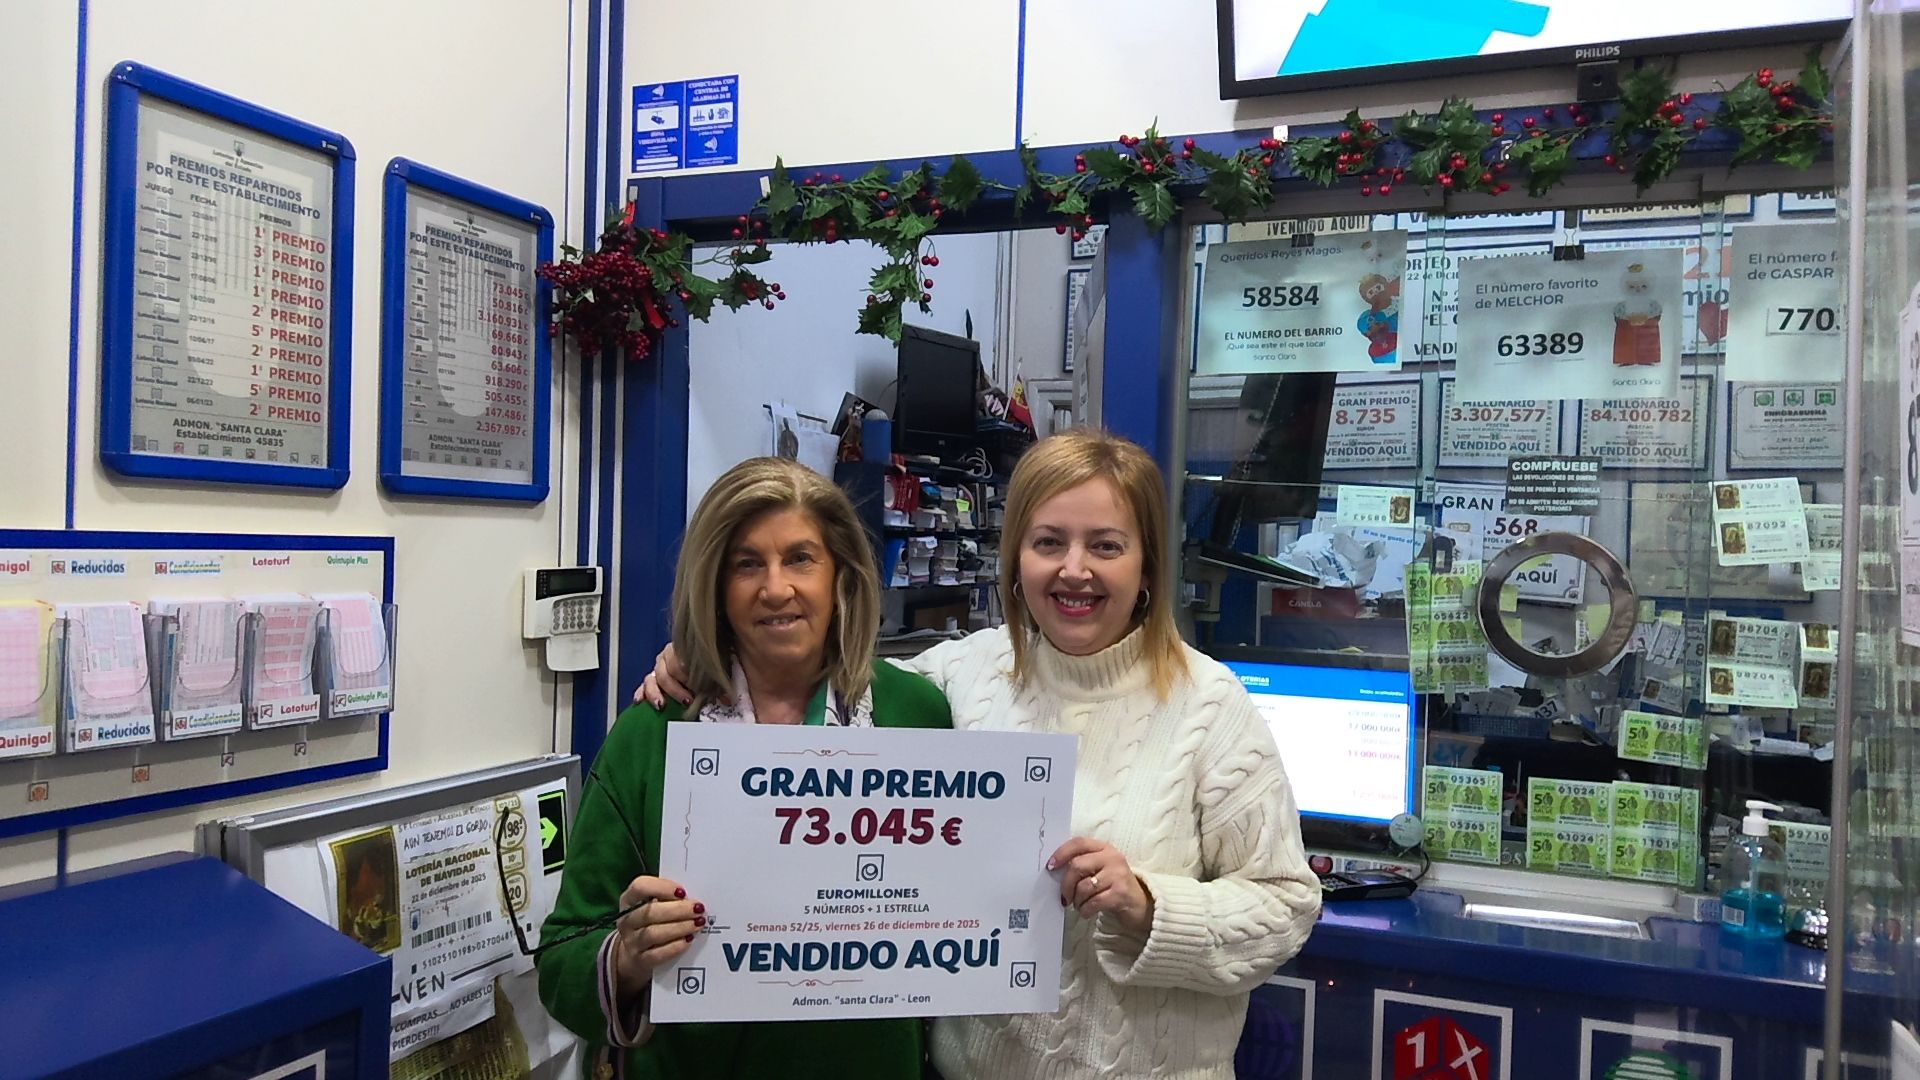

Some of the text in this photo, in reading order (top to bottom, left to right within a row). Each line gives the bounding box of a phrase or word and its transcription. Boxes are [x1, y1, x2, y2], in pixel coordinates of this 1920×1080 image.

[1576, 46, 1621, 59] PHILIPS
[170, 154, 226, 180] PREMIOS
[230, 174, 302, 202] REPARTIDOS
[145, 182, 174, 195] JUEGO
[146, 162, 174, 179] POR
[177, 170, 209, 188] ESTE
[213, 180, 321, 220] ESTABLECIMIENTO
[272, 230, 325, 254] PREMIO
[425, 225, 463, 243] PREMIOS
[464, 237, 513, 259] REPARTIDOS
[410, 232, 526, 272] POR ESTE ESTABLECIMIENTO
[1220, 249, 1303, 263] Queridos Reyes
[1749, 252, 1826, 264] El número
[272, 250, 325, 273] PREMIO
[272, 270, 324, 292] PREMIO
[1747, 268, 1834, 280] de GASPAR
[493, 282, 524, 299] 73.045
[1476, 278, 1598, 295] El número favorito
[271, 289, 324, 310] PREMIO
[1242, 285, 1320, 308] 58584
[1475, 294, 1564, 310] de MELCHOR
[492, 298, 524, 314] 50.816
[271, 308, 324, 330] PREMIO
[478, 310, 522, 330] 3.160.931
[1778, 307, 1841, 331] 770
[270, 328, 323, 348] PREMIO
[492, 329, 523, 345] 69.668
[1224, 327, 1343, 340] EL NUMERO DEL BARRIO
[491, 345, 523, 360] 80.943
[1288, 342, 1305, 350] que
[1497, 332, 1584, 357] 63389
[270, 348, 323, 367] PREMIO
[269, 367, 322, 386] PREMIO
[485, 375, 522, 391] 918.290
[269, 386, 322, 404] PREMIO
[485, 391, 522, 406] 505.455
[1339, 396, 1410, 407] GRAN PREMIO
[1602, 400, 1680, 409] MILLONARIO
[268, 407, 321, 423] PREMIO
[485, 407, 521, 421] 147.486
[1336, 408, 1395, 425] 8.735
[1451, 408, 1546, 422] 3.307.577
[1591, 409, 1692, 422] 84.100.782
[172, 418, 287, 438] ADMON. "SANTA CLARA"
[477, 421, 521, 436] 2.367.987
[177, 430, 284, 447] Establecimiento 45835
[429, 434, 453, 443] ADMON.
[1452, 440, 1541, 452] VENDIDO AQUÍ
[431, 443, 480, 454] Establecimiento
[1325, 443, 1407, 456] VENDIDO AQUÍ
[1590, 445, 1688, 459] VENDIDO AQUÍ
[1512, 461, 1598, 472] COMPRUEBE
[1442, 496, 1494, 511] GRAN
[252, 556, 290, 567] Lototurf
[357, 556, 369, 564] Plus
[1516, 569, 1558, 584] AQUÍ
[1289, 600, 1322, 608] CANELA
[0, 732, 51, 749] Quinigol
[281, 701, 318, 715] Lototurf
[377, 690, 388, 700] Plus
[741, 766, 1006, 800] GRAN PREMIO
[1451, 775, 1486, 786] 05365
[1558, 786, 1595, 796] 61024
[774, 808, 963, 846] 73.045 €
[1557, 832, 1594, 843] 61024
[406, 848, 491, 880] LOTERÍA NACIONAL
[421, 863, 476, 888] DE NAVIDAD
[411, 895, 420, 904] 22
[428, 882, 460, 897] diciembre
[461, 879, 470, 887] de
[471, 873, 486, 884] 2025
[508, 886, 522, 900] 20
[817, 888, 920, 900] EUROMILLONES
[804, 906, 810, 914] 5
[813, 903, 865, 914] NÚMEROS
[876, 905, 881, 913] 1
[884, 904, 930, 913] ESTRELLA
[747, 920, 980, 933] Semana 52/25, viernes 26 de diciembre de 2025
[722, 928, 1001, 974] VENDIDO AQUÍ
[400, 971, 445, 1004] VEN
[450, 984, 493, 1011] NO SABES LO
[792, 996, 832, 1006] Admon.
[835, 995, 867, 1005] "santa
[869, 994, 899, 1004] Clara"
[908, 994, 931, 1003] Leon
[1407, 1028, 1483, 1080] 1 X
